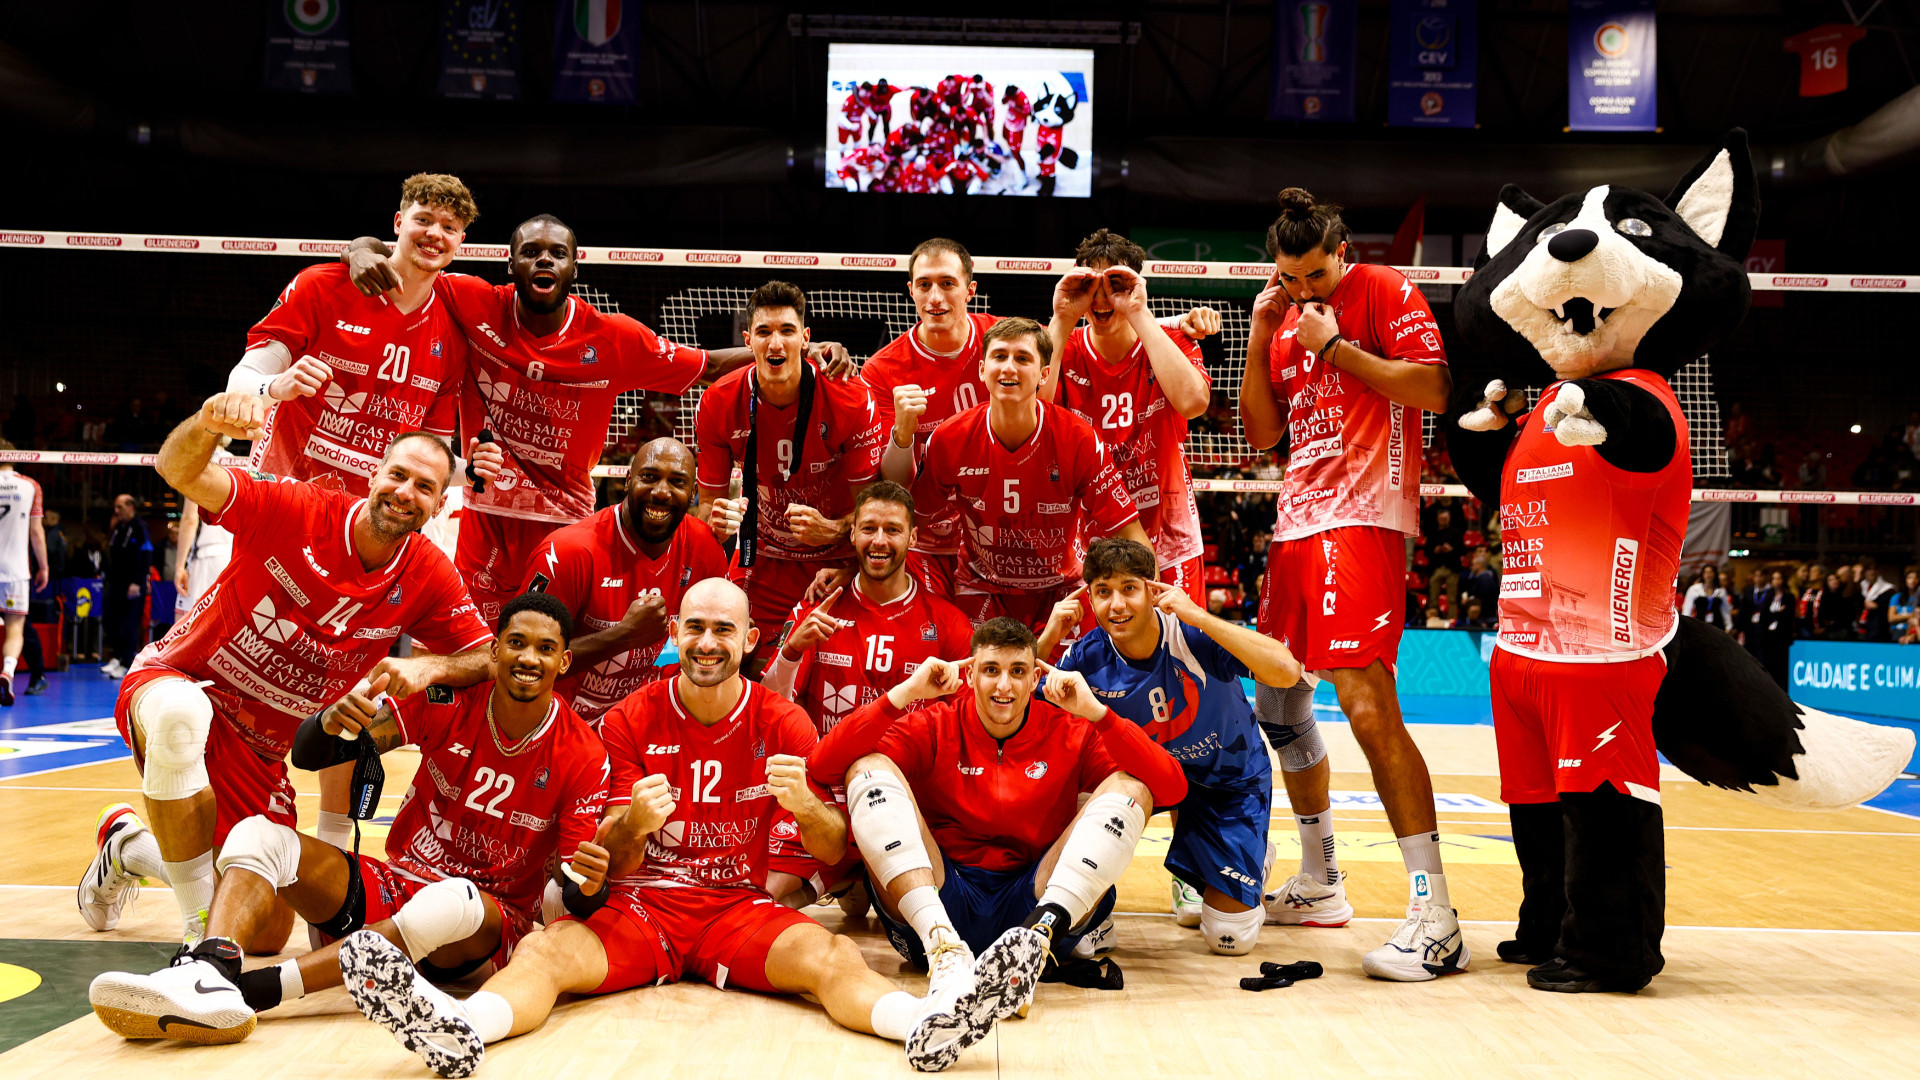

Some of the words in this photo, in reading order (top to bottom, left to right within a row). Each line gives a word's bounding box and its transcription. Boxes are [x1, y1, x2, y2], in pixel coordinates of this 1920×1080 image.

[1811, 46, 1837, 70] 16
[1, 234, 41, 243] UENERGY
[69, 236, 121, 246] BLUENERGY
[147, 239, 198, 248] BLUENERGY
[224, 242, 275, 251] BLUENERGY
[611, 251, 661, 261] BLUENERGY
[688, 253, 739, 263] BLUENERGY
[766, 256, 816, 265] BLUENERGY
[843, 258, 894, 267] BLUENERGY
[998, 261, 1050, 271] BLUENERGY
[1154, 265, 1205, 275] BLUENERGY
[1402, 271, 1437, 280] ENERGY
[1775, 279, 1826, 288] BLUENERGY
[1853, 281, 1904, 289] BLUENERGY
[1389, 310, 1426, 330] IVECO
[1396, 323, 1424, 342] ARA
[329, 356, 367, 371] ITALIANA
[377, 343, 410, 384] 20
[526, 361, 545, 381] 6
[1324, 372, 1340, 385] DI
[515, 387, 561, 408] BANCA
[566, 400, 581, 411] DI
[366, 404, 423, 427] PIACENZA
[414, 404, 426, 417] DI
[512, 398, 580, 421] PIACENZA
[1101, 392, 1133, 429] 23
[355, 422, 384, 439] GAS
[504, 412, 530, 430] GAS
[534, 422, 572, 439] SALES
[503, 424, 569, 450] ENERGIA
[1391, 401, 1403, 486] BLUENERGY
[65, 455, 116, 464] BLUENERGY
[308, 440, 378, 472] nordmecc
[777, 439, 793, 474] 9
[1126, 458, 1157, 479] SALES
[1527, 470, 1572, 481] ASSICURAZIONI
[1528, 464, 1571, 476] ITALIANA
[495, 473, 516, 485] BFT
[1128, 471, 1159, 490] RGIA
[1003, 479, 1020, 514] 5
[1292, 489, 1335, 506] BURZONI
[1704, 493, 1753, 501] BLUENERGY
[1782, 494, 1832, 502] BLUENERGY
[1528, 500, 1547, 513] DI
[999, 527, 1045, 539] BANCA
[1050, 527, 1065, 537] DI
[998, 537, 1067, 550] PIACENZA
[1507, 538, 1544, 553] SALES
[995, 554, 1022, 566] GAS
[1026, 552, 1063, 566] SALES
[276, 563, 308, 603] ITALIANA
[1615, 544, 1634, 643] BLUENERGY
[316, 596, 363, 636] 14
[290, 640, 360, 673] PIACENZA
[299, 631, 348, 662] BANCA
[351, 652, 368, 663] DI
[866, 634, 895, 672] 15
[820, 652, 851, 662] ITALIANA
[272, 654, 304, 678] GAS
[304, 673, 346, 691] SALES
[1793, 660, 1857, 691] CALDAIE
[1860, 663, 1870, 690] E
[213, 653, 318, 715] nordmeccanica
[263, 664, 336, 701] ENERGIA
[1148, 687, 1170, 723] 8
[1183, 730, 1218, 753] SALES
[690, 760, 722, 803] 12
[743, 785, 767, 795] ITALIA
[360, 784, 374, 818] OVERTRAQ
[464, 766, 515, 819] 22
[576, 790, 608, 805] IVEC
[690, 821, 740, 835] BANCA
[744, 817, 759, 832] DI
[457, 826, 508, 856] BANCA
[444, 854, 468, 874] GAS
